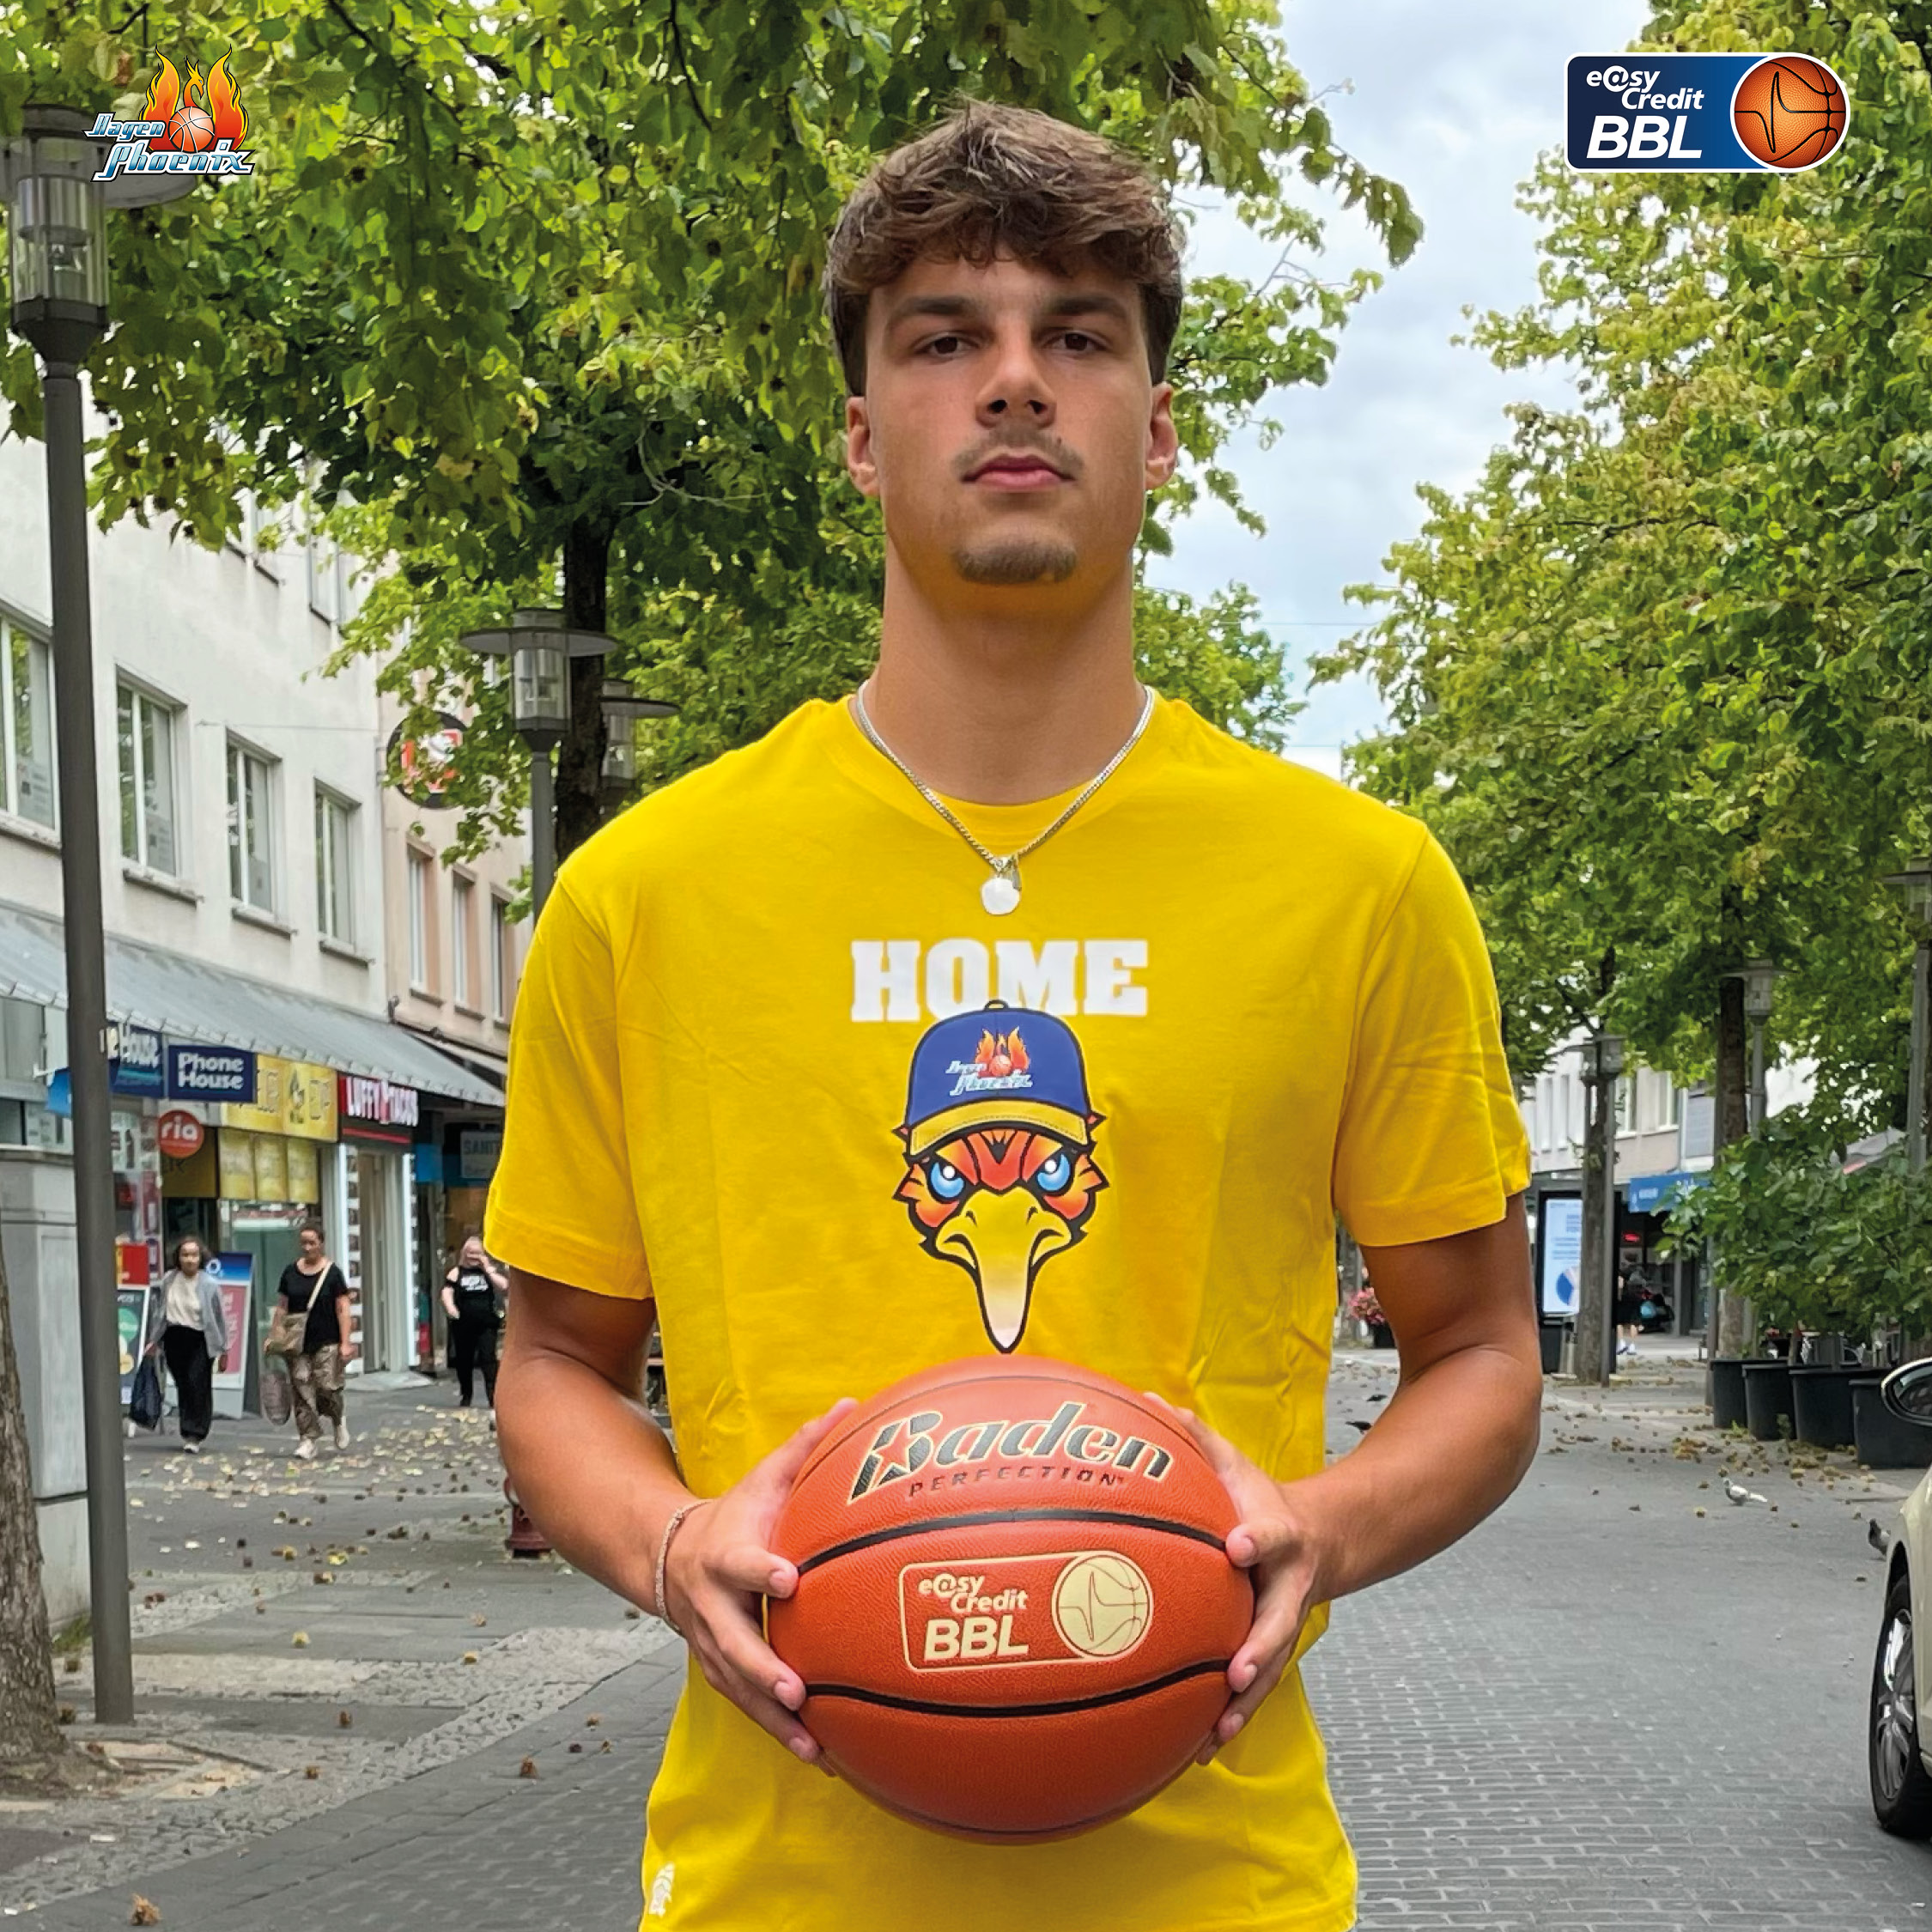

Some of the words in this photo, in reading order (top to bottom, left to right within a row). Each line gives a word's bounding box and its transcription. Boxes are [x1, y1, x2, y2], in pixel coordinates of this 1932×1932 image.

[850, 938, 1149, 1023] HOME
[177, 1052, 245, 1073] Phone
[177, 1070, 245, 1091] House
[161, 1115, 198, 1141] ria
[846, 1400, 1174, 1505] Baden
[908, 1465, 1121, 1498] PERFECTION
[918, 1573, 986, 1599] e@sy
[950, 1589, 1029, 1614] Credit
[923, 1613, 1030, 1662] BBL
